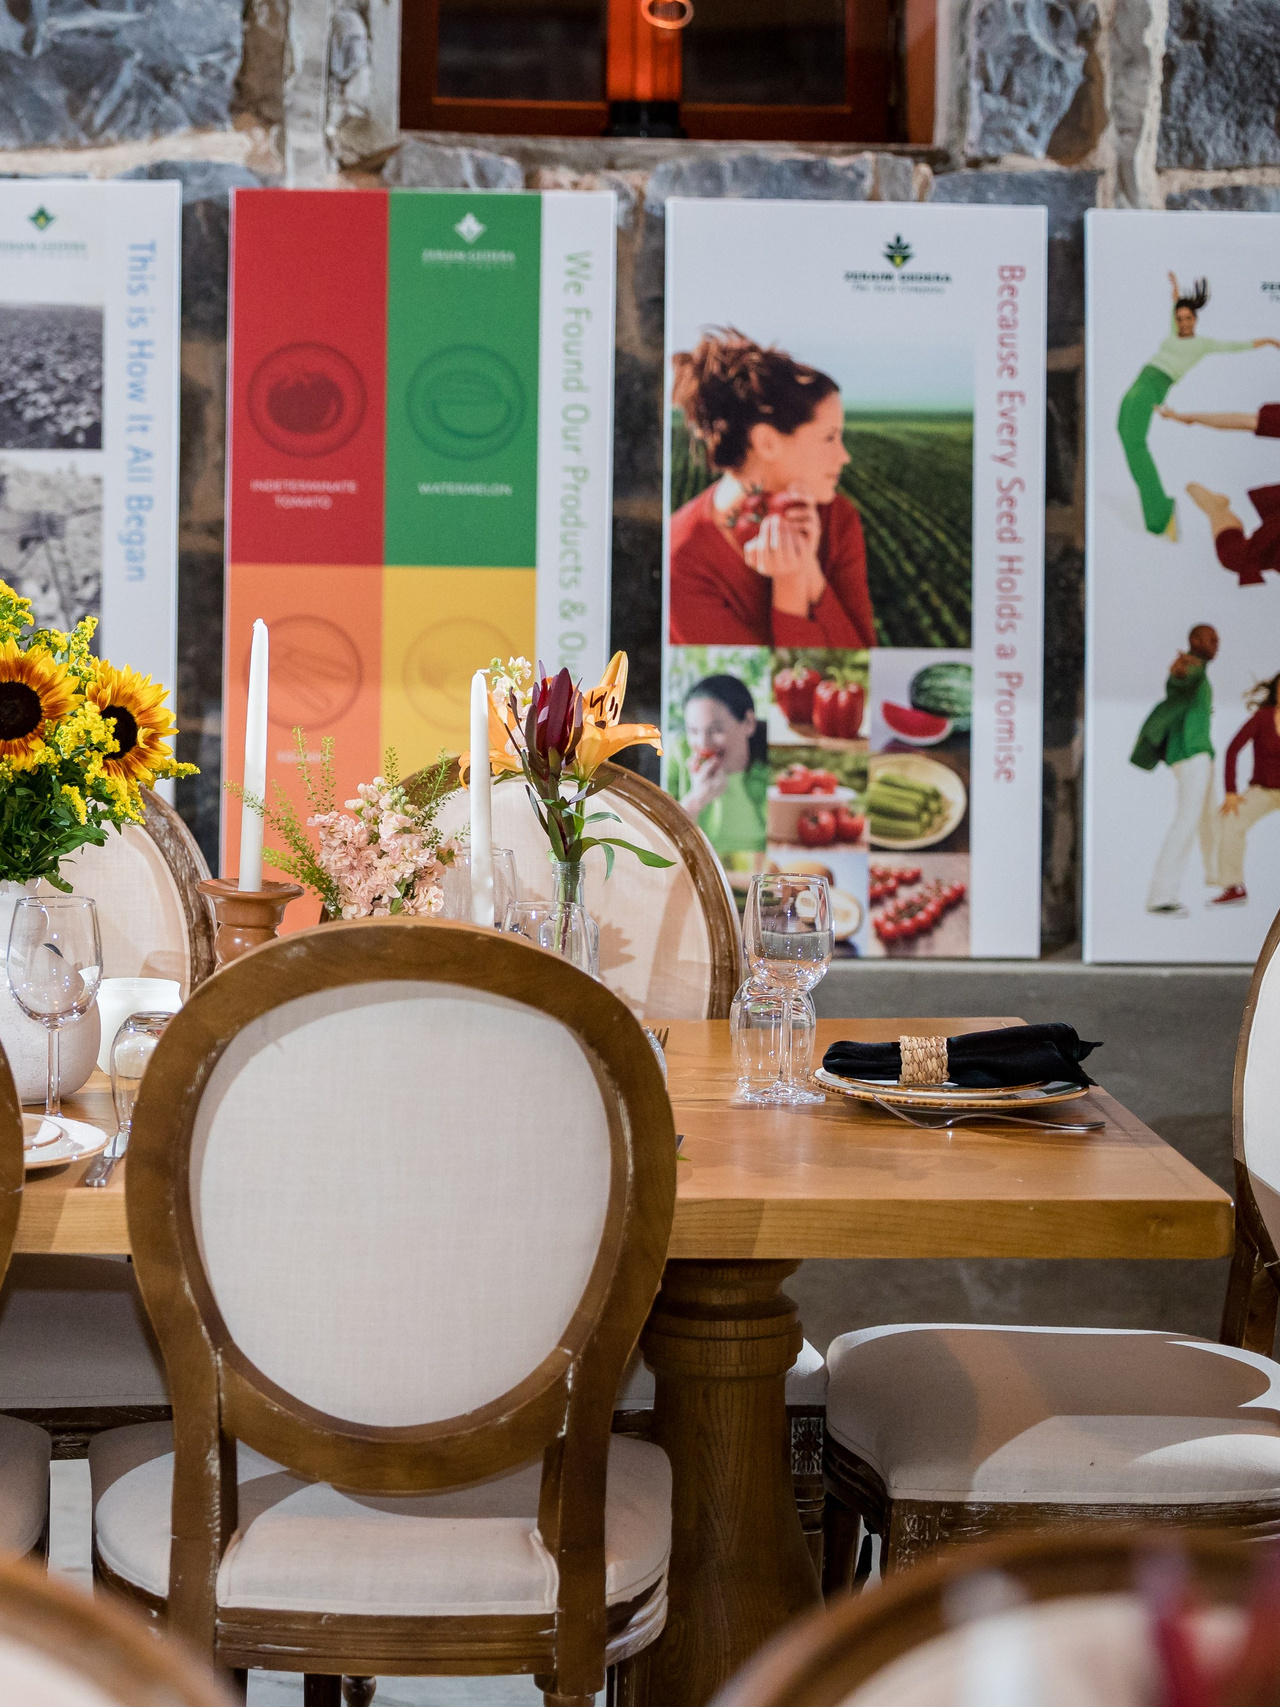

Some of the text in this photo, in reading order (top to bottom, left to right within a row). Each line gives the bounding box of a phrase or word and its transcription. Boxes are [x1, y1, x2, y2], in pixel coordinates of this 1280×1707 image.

[565, 252, 591, 294] We
[563, 308, 592, 391] Found
[119, 241, 156, 581] This is How It All Began
[562, 404, 590, 453] Our
[560, 466, 589, 588] Products
[992, 265, 1026, 783] Because Every Seed Holds a Promise
[560, 600, 586, 620] &
